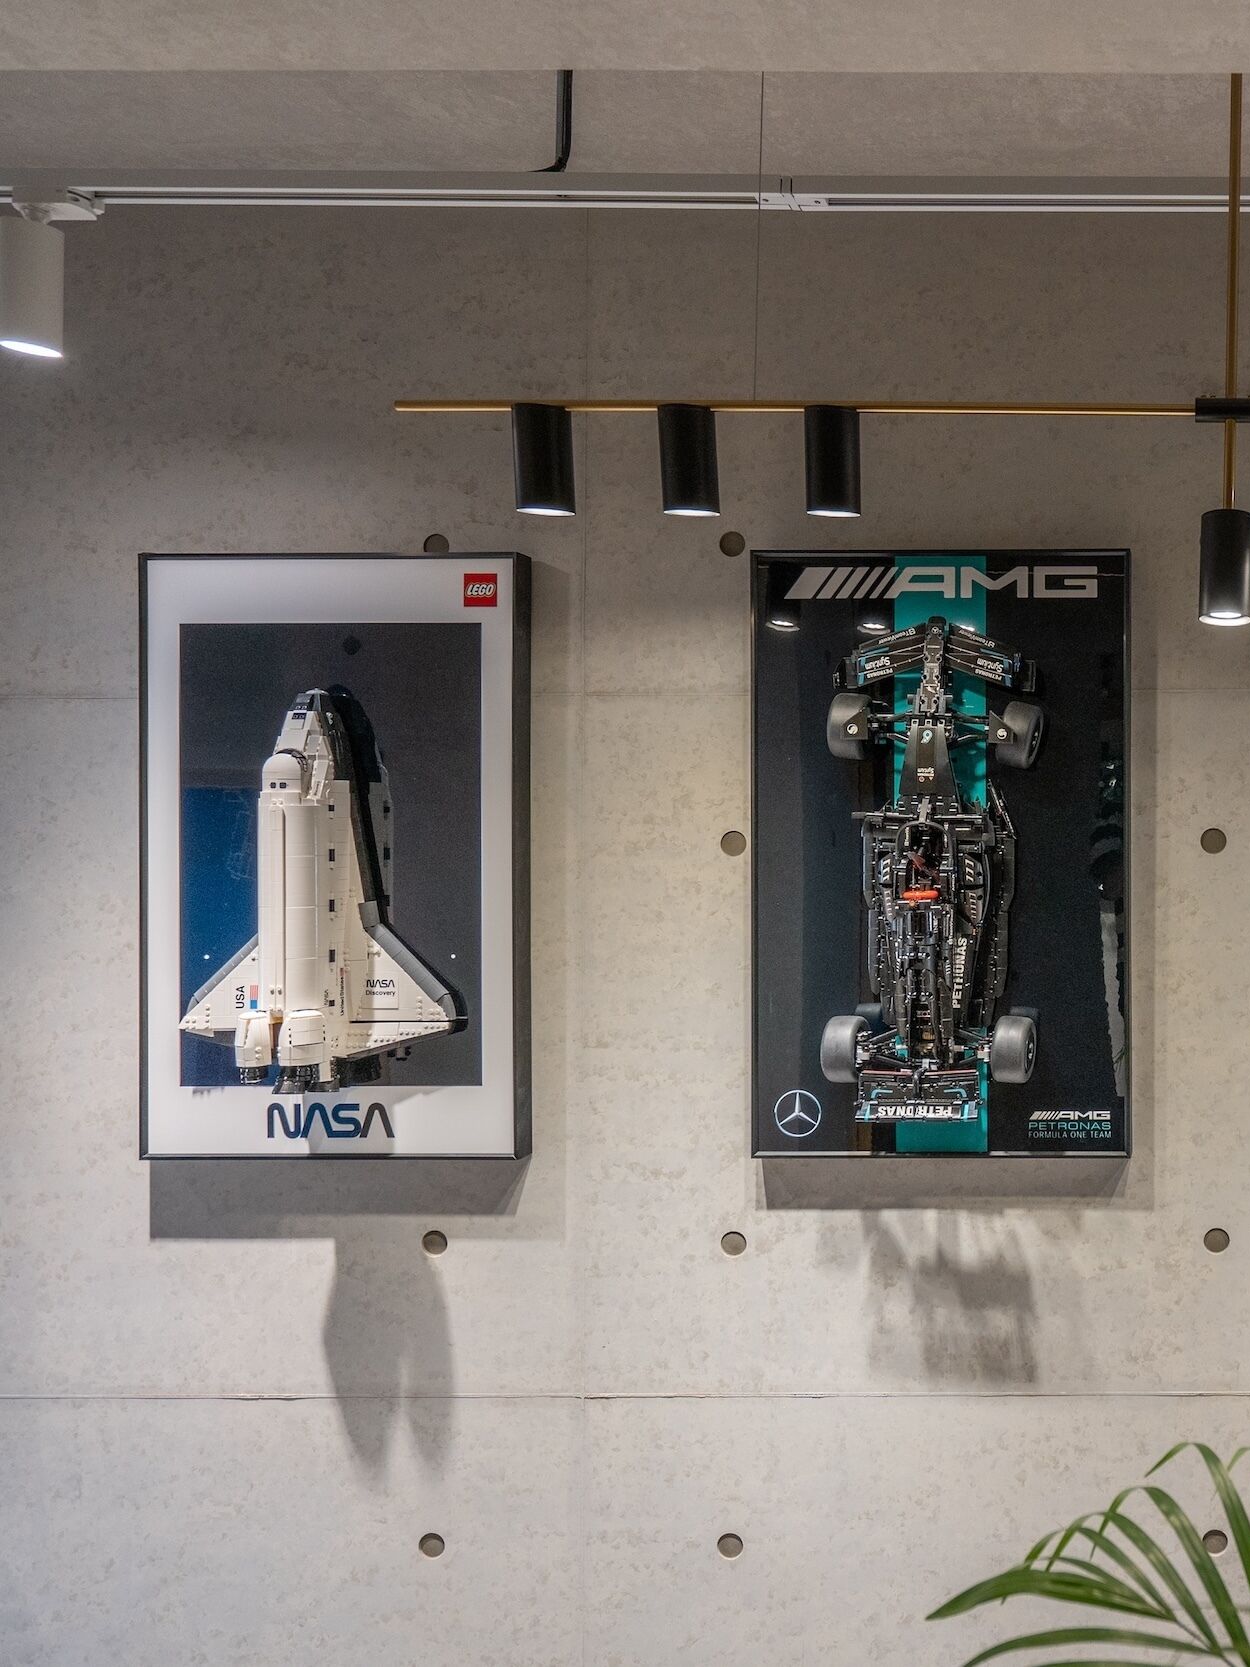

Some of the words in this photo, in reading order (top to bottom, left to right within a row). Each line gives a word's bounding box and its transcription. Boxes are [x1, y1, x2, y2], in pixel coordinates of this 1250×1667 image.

[881, 566, 1098, 599] AMG
[465, 582, 497, 598] LEGO
[366, 979, 395, 988] NASA
[235, 985, 245, 1009] USA
[365, 989, 396, 997] Discovery
[1056, 1110, 1111, 1120] AMG
[266, 1102, 395, 1139] NASA
[1028, 1121, 1112, 1131] PETRONAS
[1028, 1131, 1068, 1139] FORMULA
[1070, 1131, 1087, 1139] ONE
[1090, 1131, 1112, 1139] TEAM
